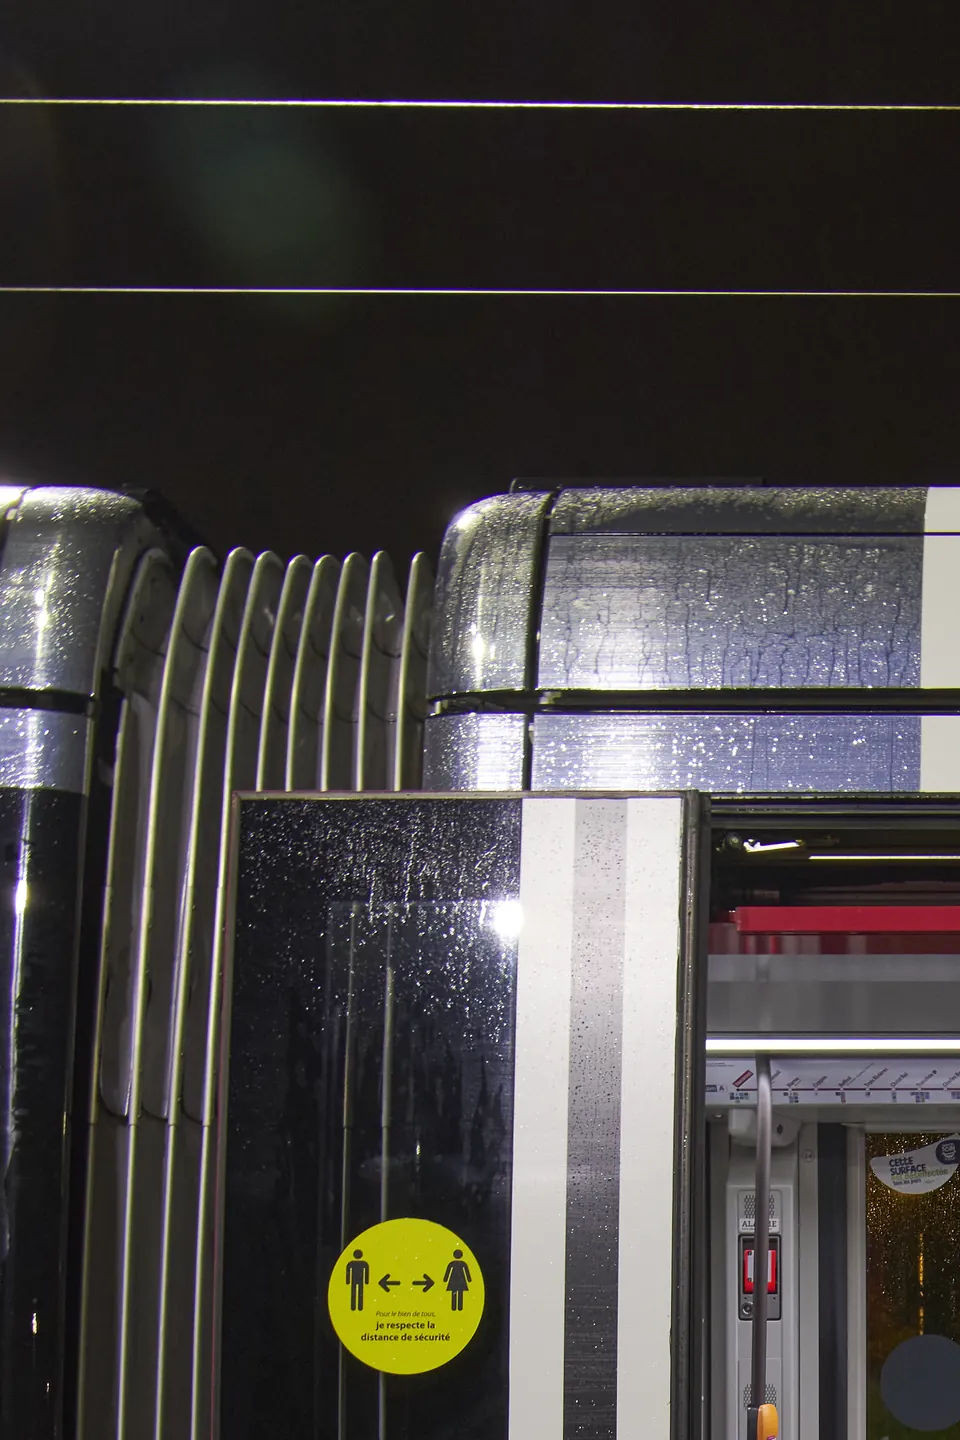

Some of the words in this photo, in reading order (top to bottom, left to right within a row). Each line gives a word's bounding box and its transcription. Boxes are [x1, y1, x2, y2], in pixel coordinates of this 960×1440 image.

[890, 1164, 926, 1176] SURFACE
[376, 1322, 384, 1331] je
[387, 1322, 425, 1330] respecte
[414, 1333, 450, 1341] sécurité
